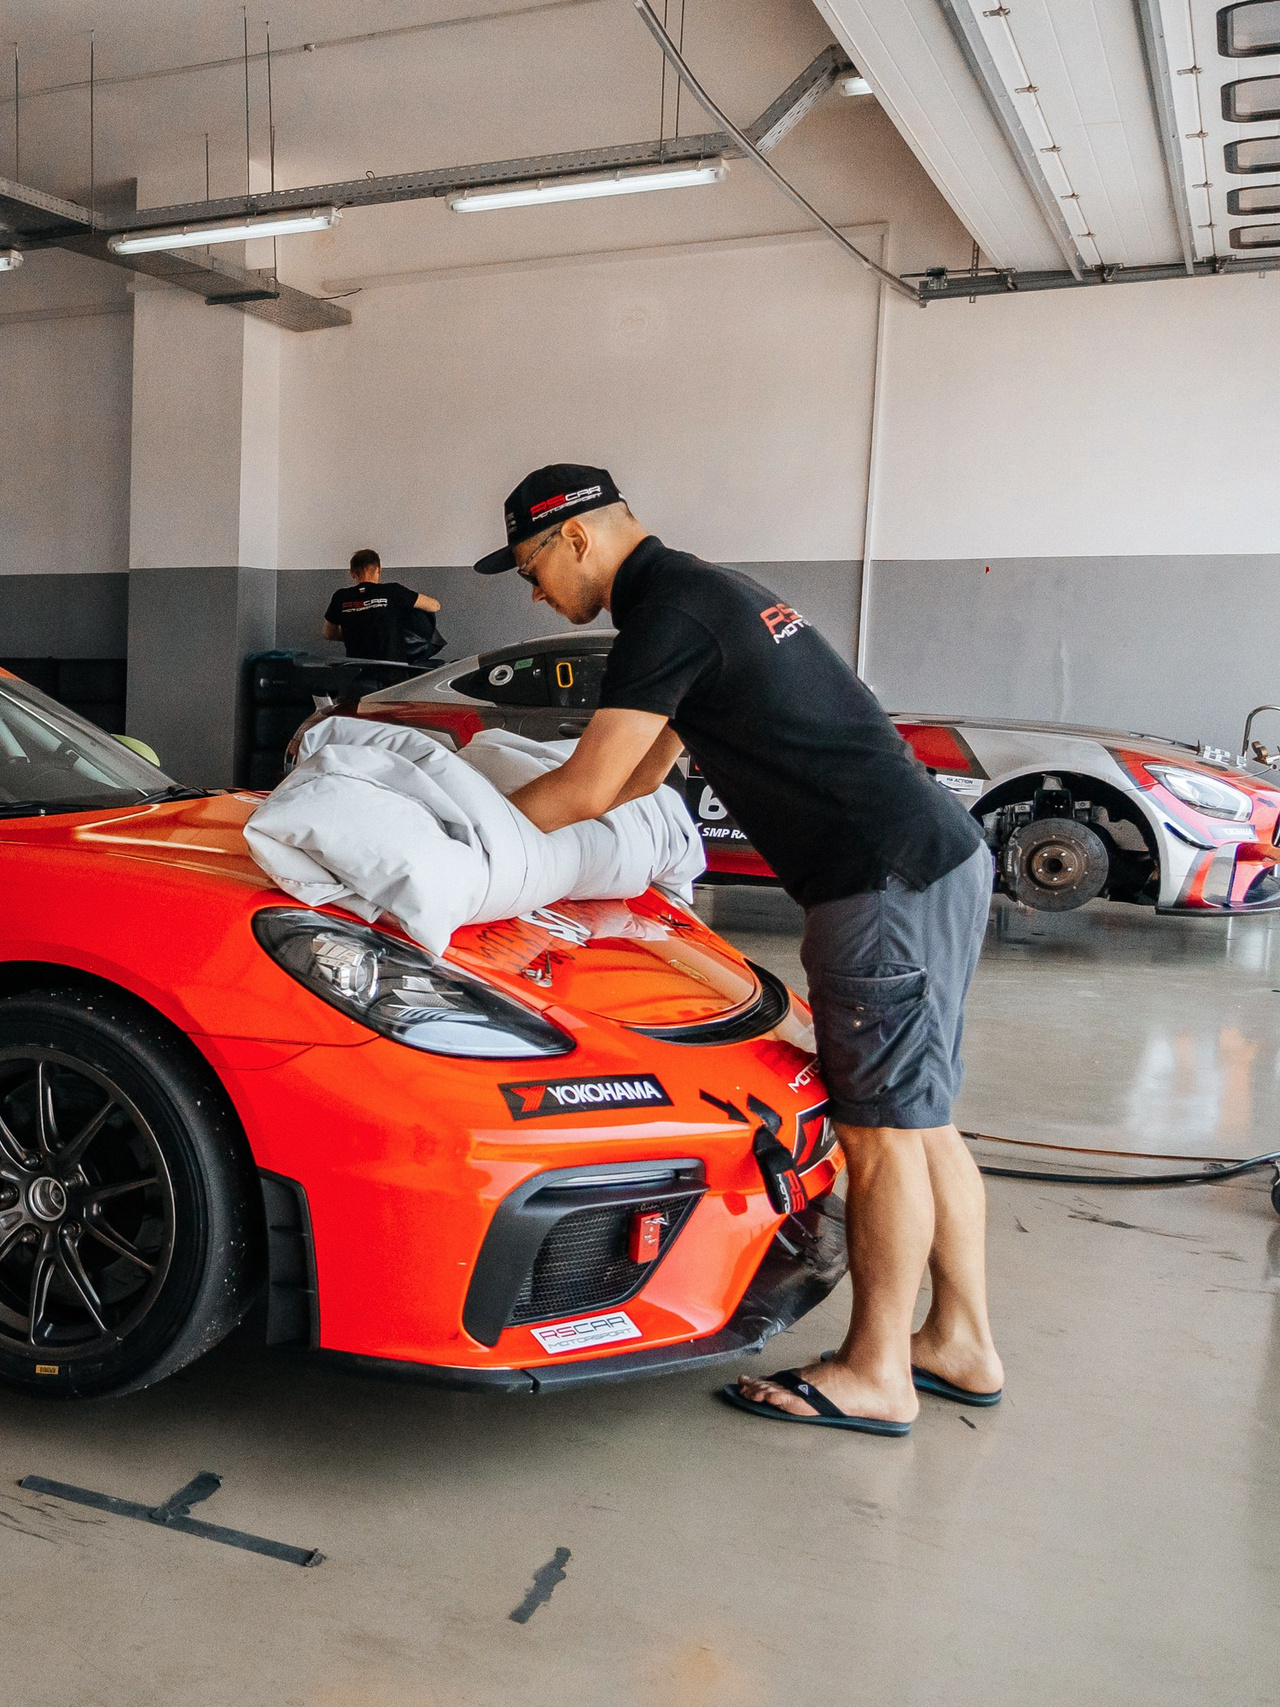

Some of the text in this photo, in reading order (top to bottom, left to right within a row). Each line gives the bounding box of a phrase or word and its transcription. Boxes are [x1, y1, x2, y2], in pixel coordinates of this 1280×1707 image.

[530, 485, 601, 515] RSCAR
[532, 492, 602, 521] MOTORSPORT
[702, 827, 730, 838] SMP
[547, 1080, 662, 1105] YOKOHAMA
[539, 1316, 627, 1341] RSCAR
[548, 1328, 632, 1349] MOTORSPORT
